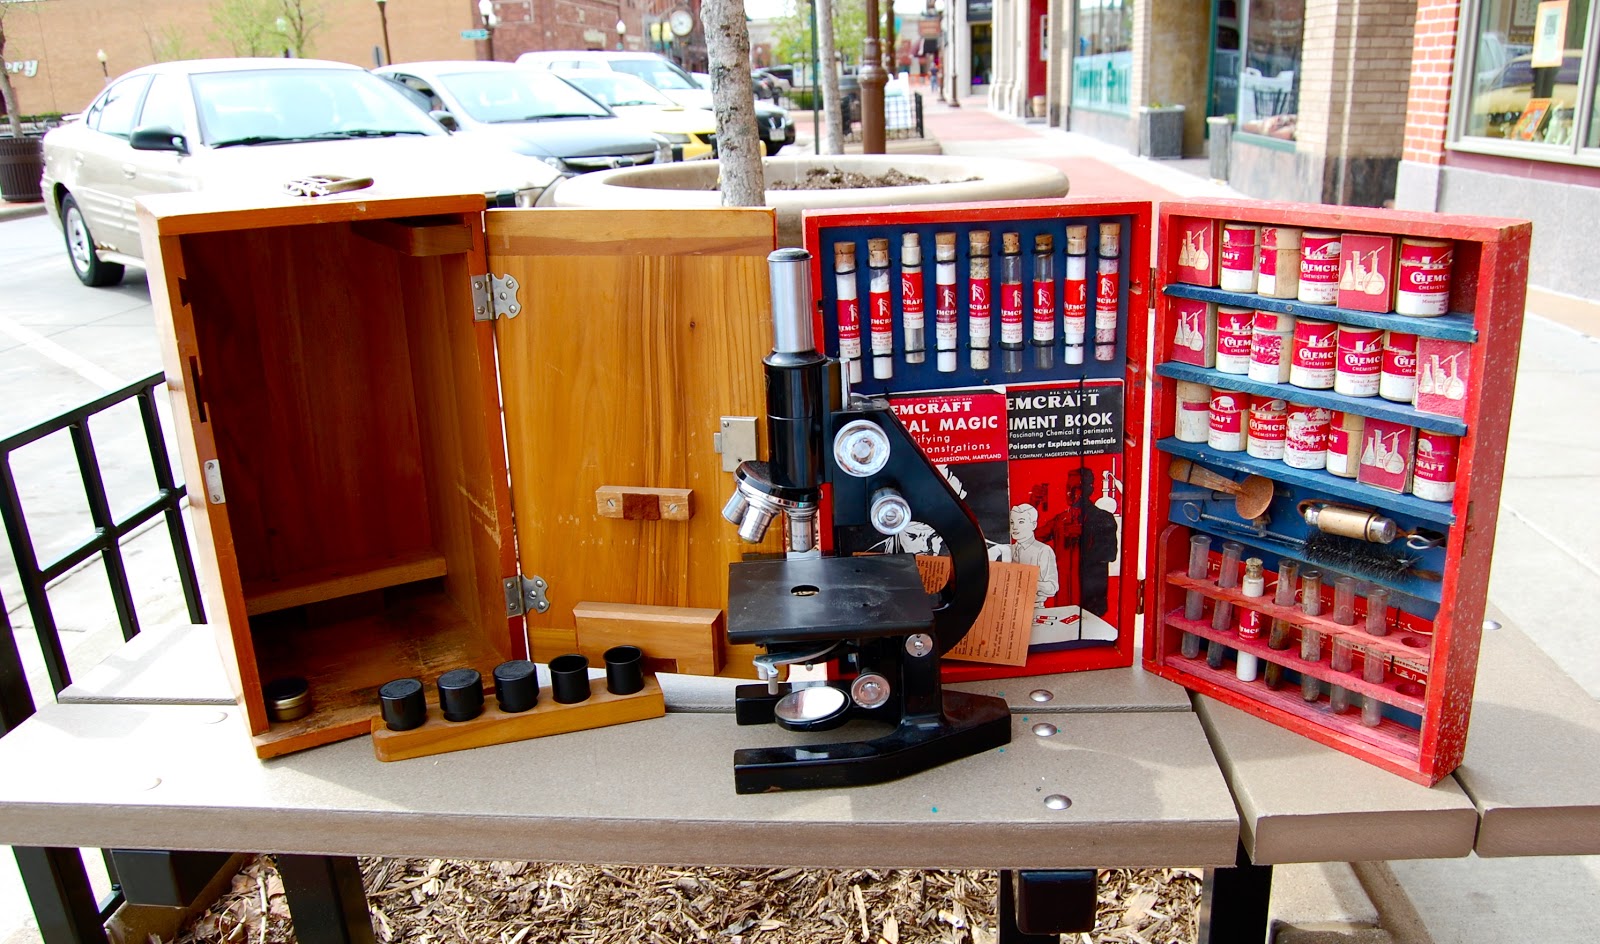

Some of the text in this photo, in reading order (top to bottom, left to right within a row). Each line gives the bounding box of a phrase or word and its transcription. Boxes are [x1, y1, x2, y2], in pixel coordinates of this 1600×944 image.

[939, 416, 998, 431] MAGIC
[1010, 412, 1113, 430] IMENT BOOK
[914, 434, 950, 444] ifying
[1010, 426, 1114, 439] Fascinating Chemical Eperiments
[1008, 442, 1036, 450] Poisons
[1048, 439, 1080, 448] Explosive
[1082, 436, 1116, 446] Chemicals
